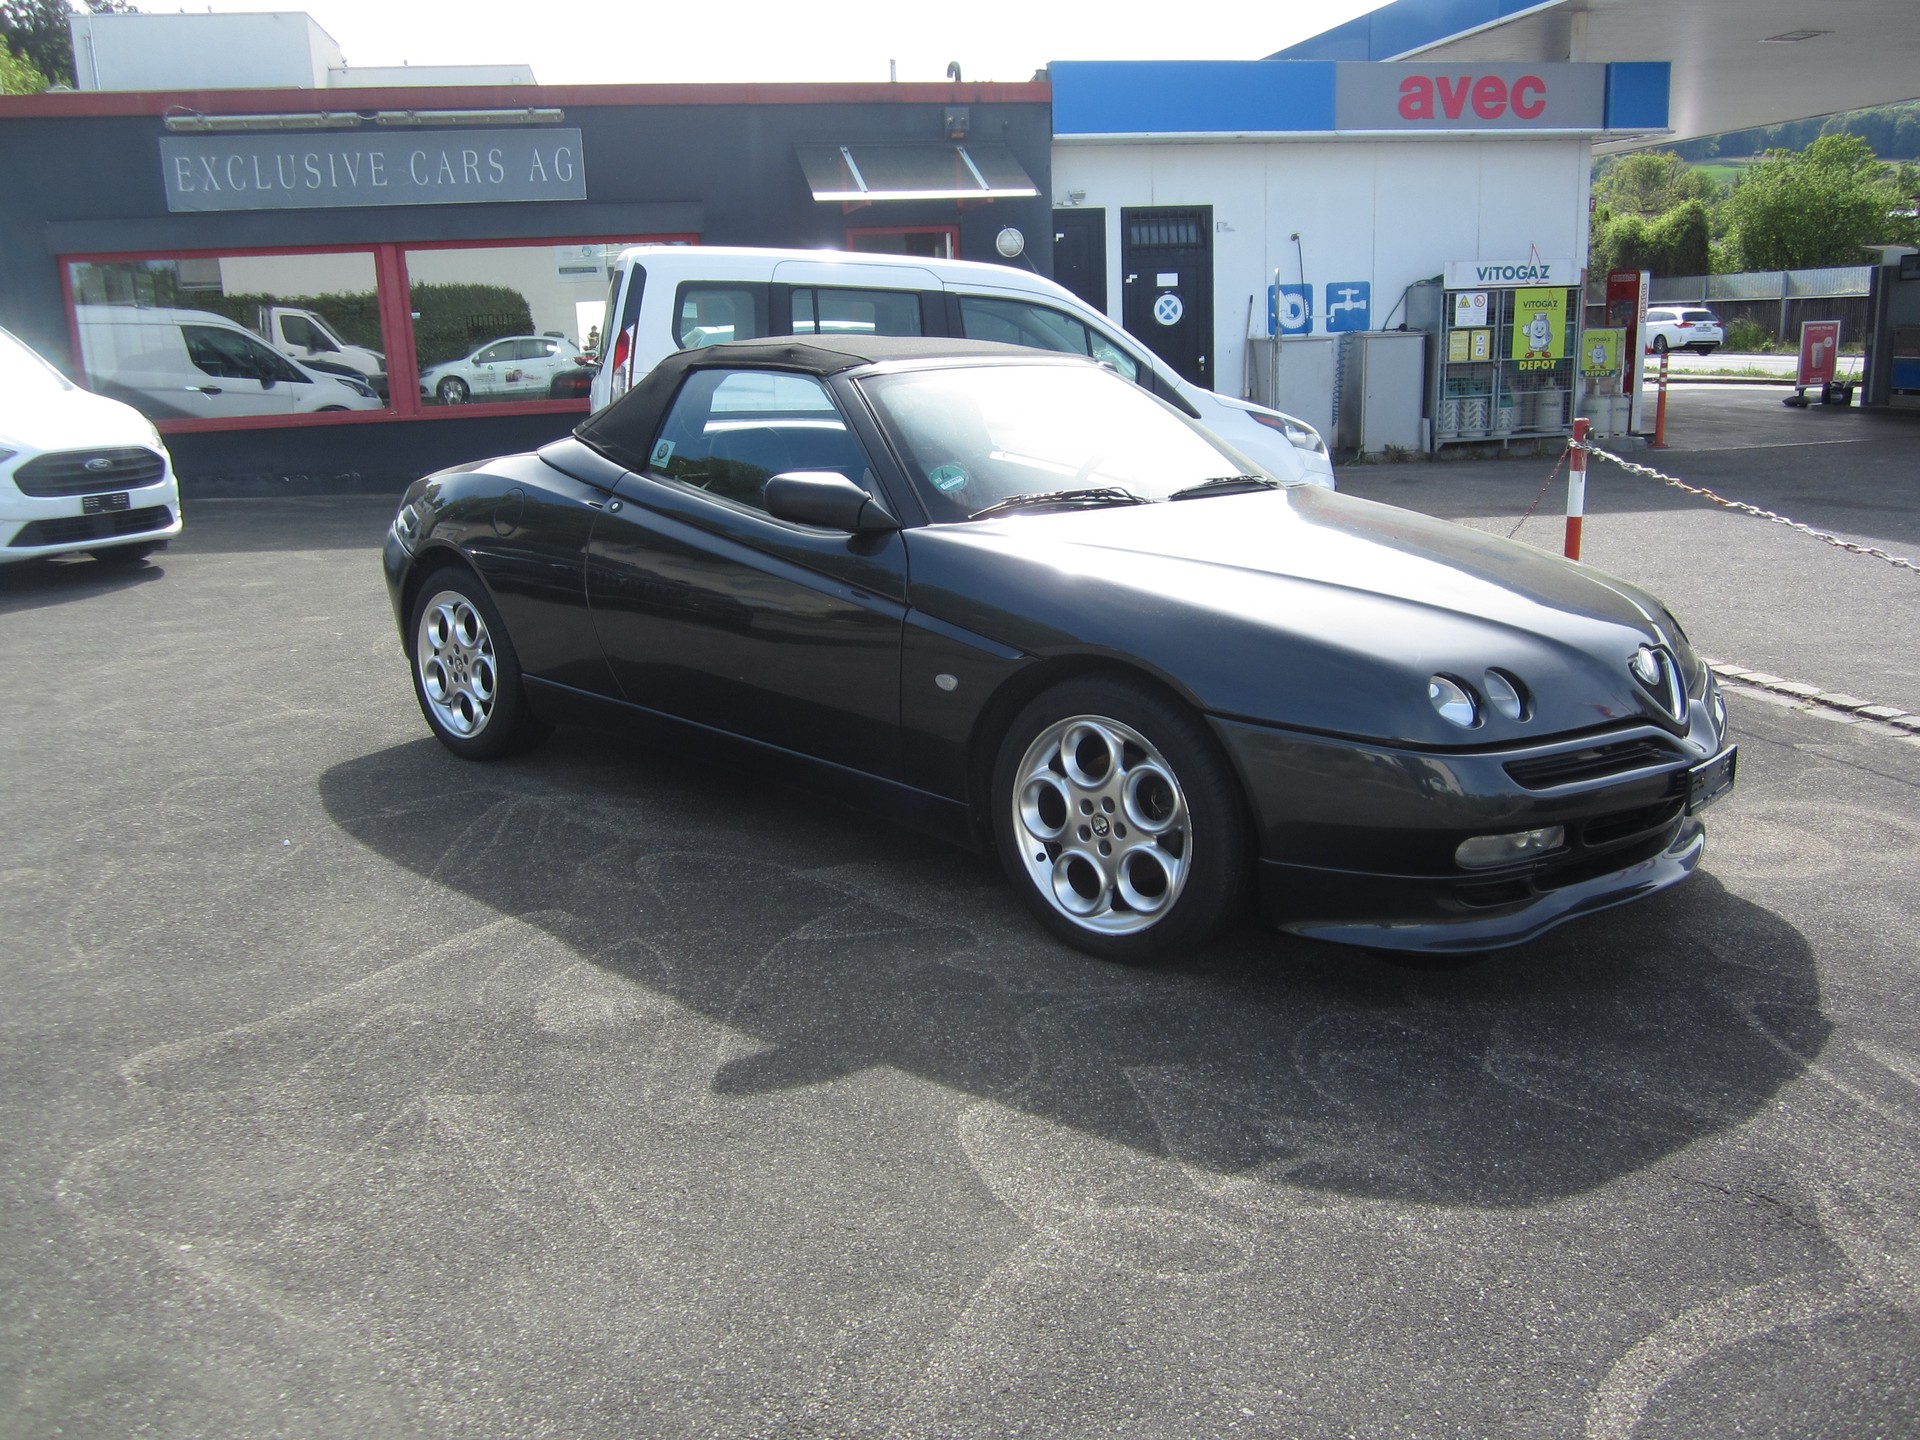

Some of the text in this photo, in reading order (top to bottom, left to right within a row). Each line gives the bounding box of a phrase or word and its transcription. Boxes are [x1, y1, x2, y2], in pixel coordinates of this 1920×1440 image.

[1398, 75, 1547, 120] avec
[174, 147, 575, 192] EXCLUSIVE CARS AG
[1519, 360, 1556, 371] DEPOT
